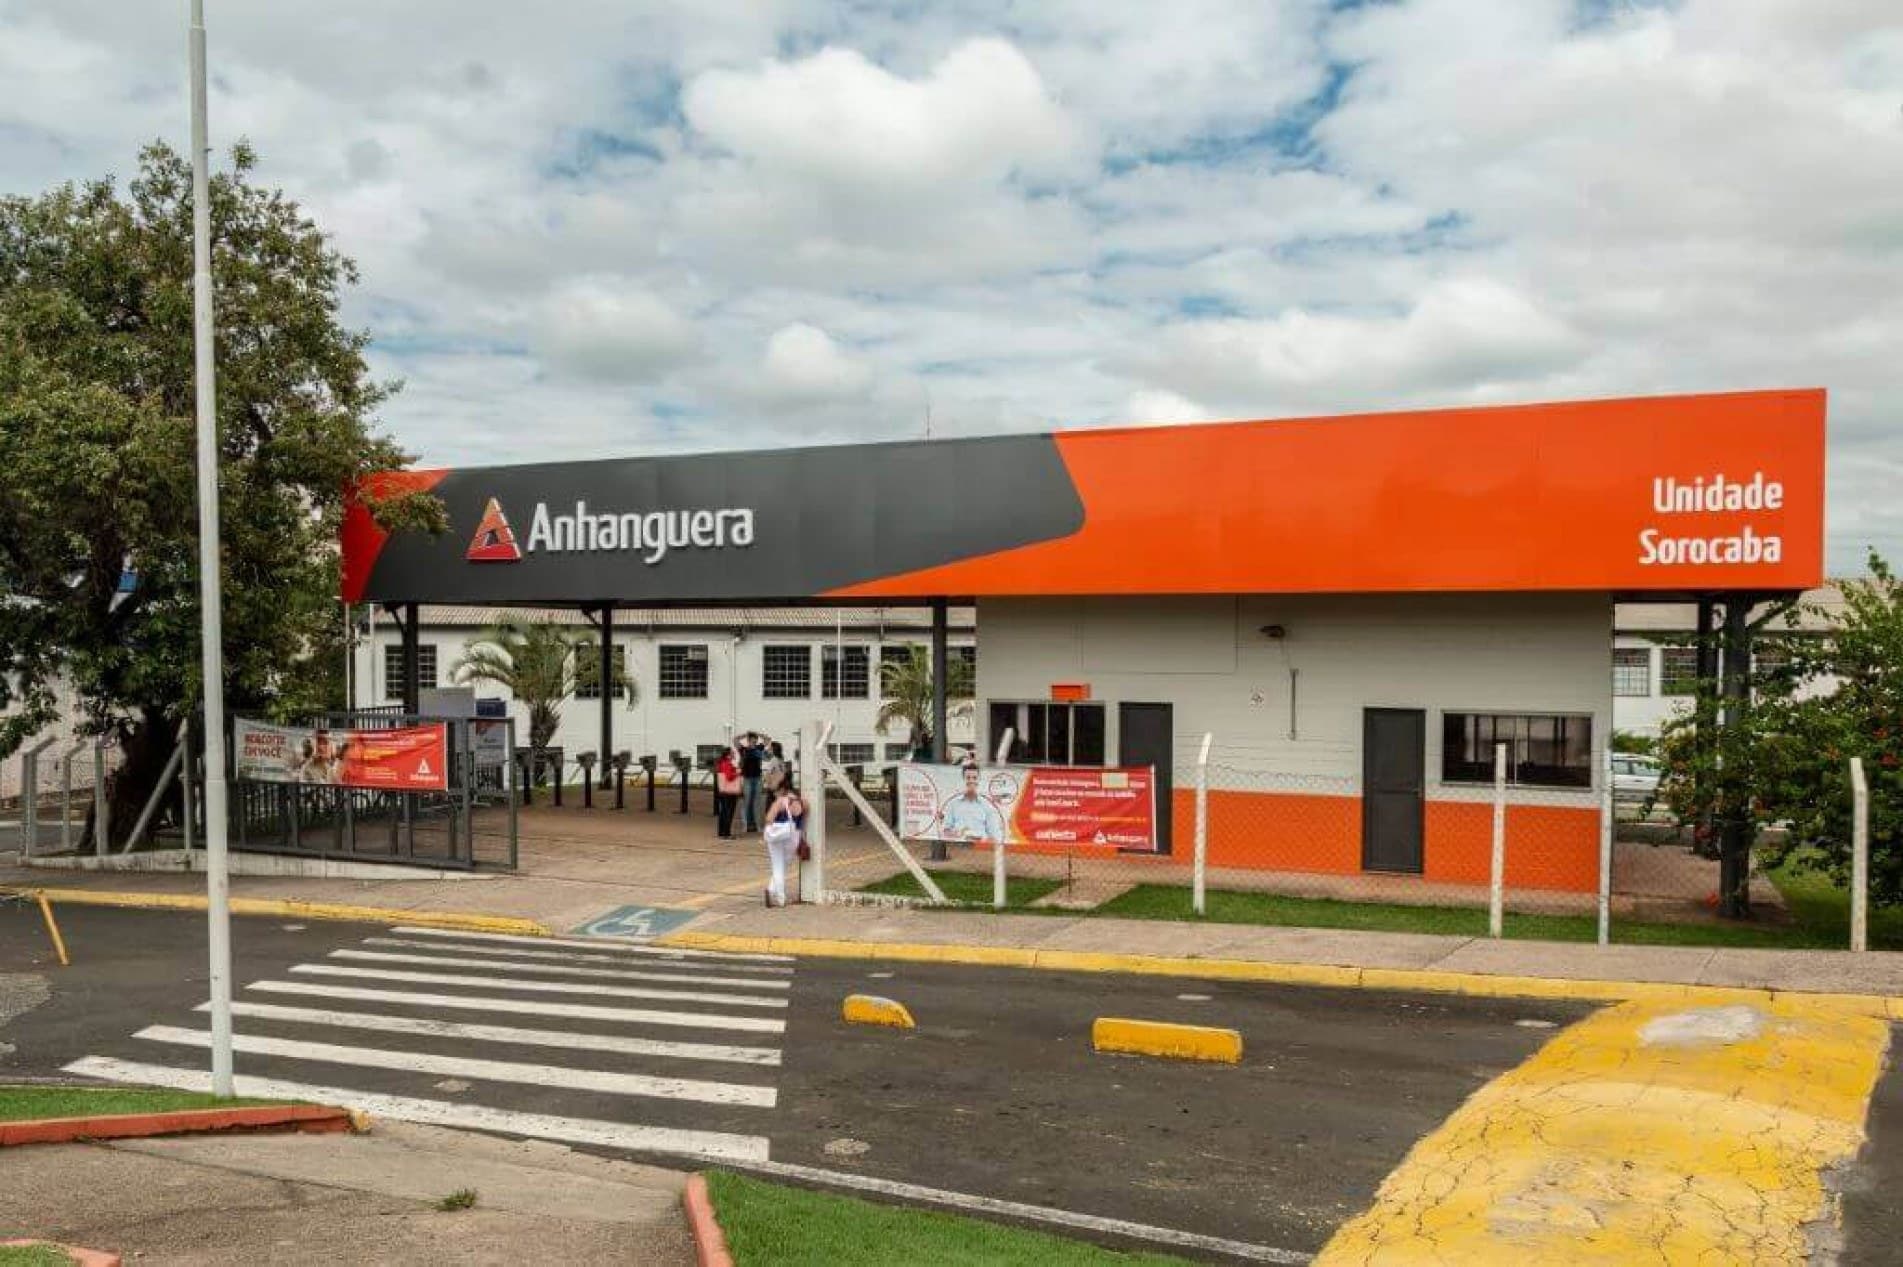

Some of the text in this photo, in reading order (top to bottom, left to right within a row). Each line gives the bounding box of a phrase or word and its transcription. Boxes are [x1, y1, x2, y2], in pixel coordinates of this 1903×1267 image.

[1653, 471, 1783, 512] Unidade
[527, 500, 754, 564] Anhanguera
[1638, 525, 1781, 563] Sorocaba
